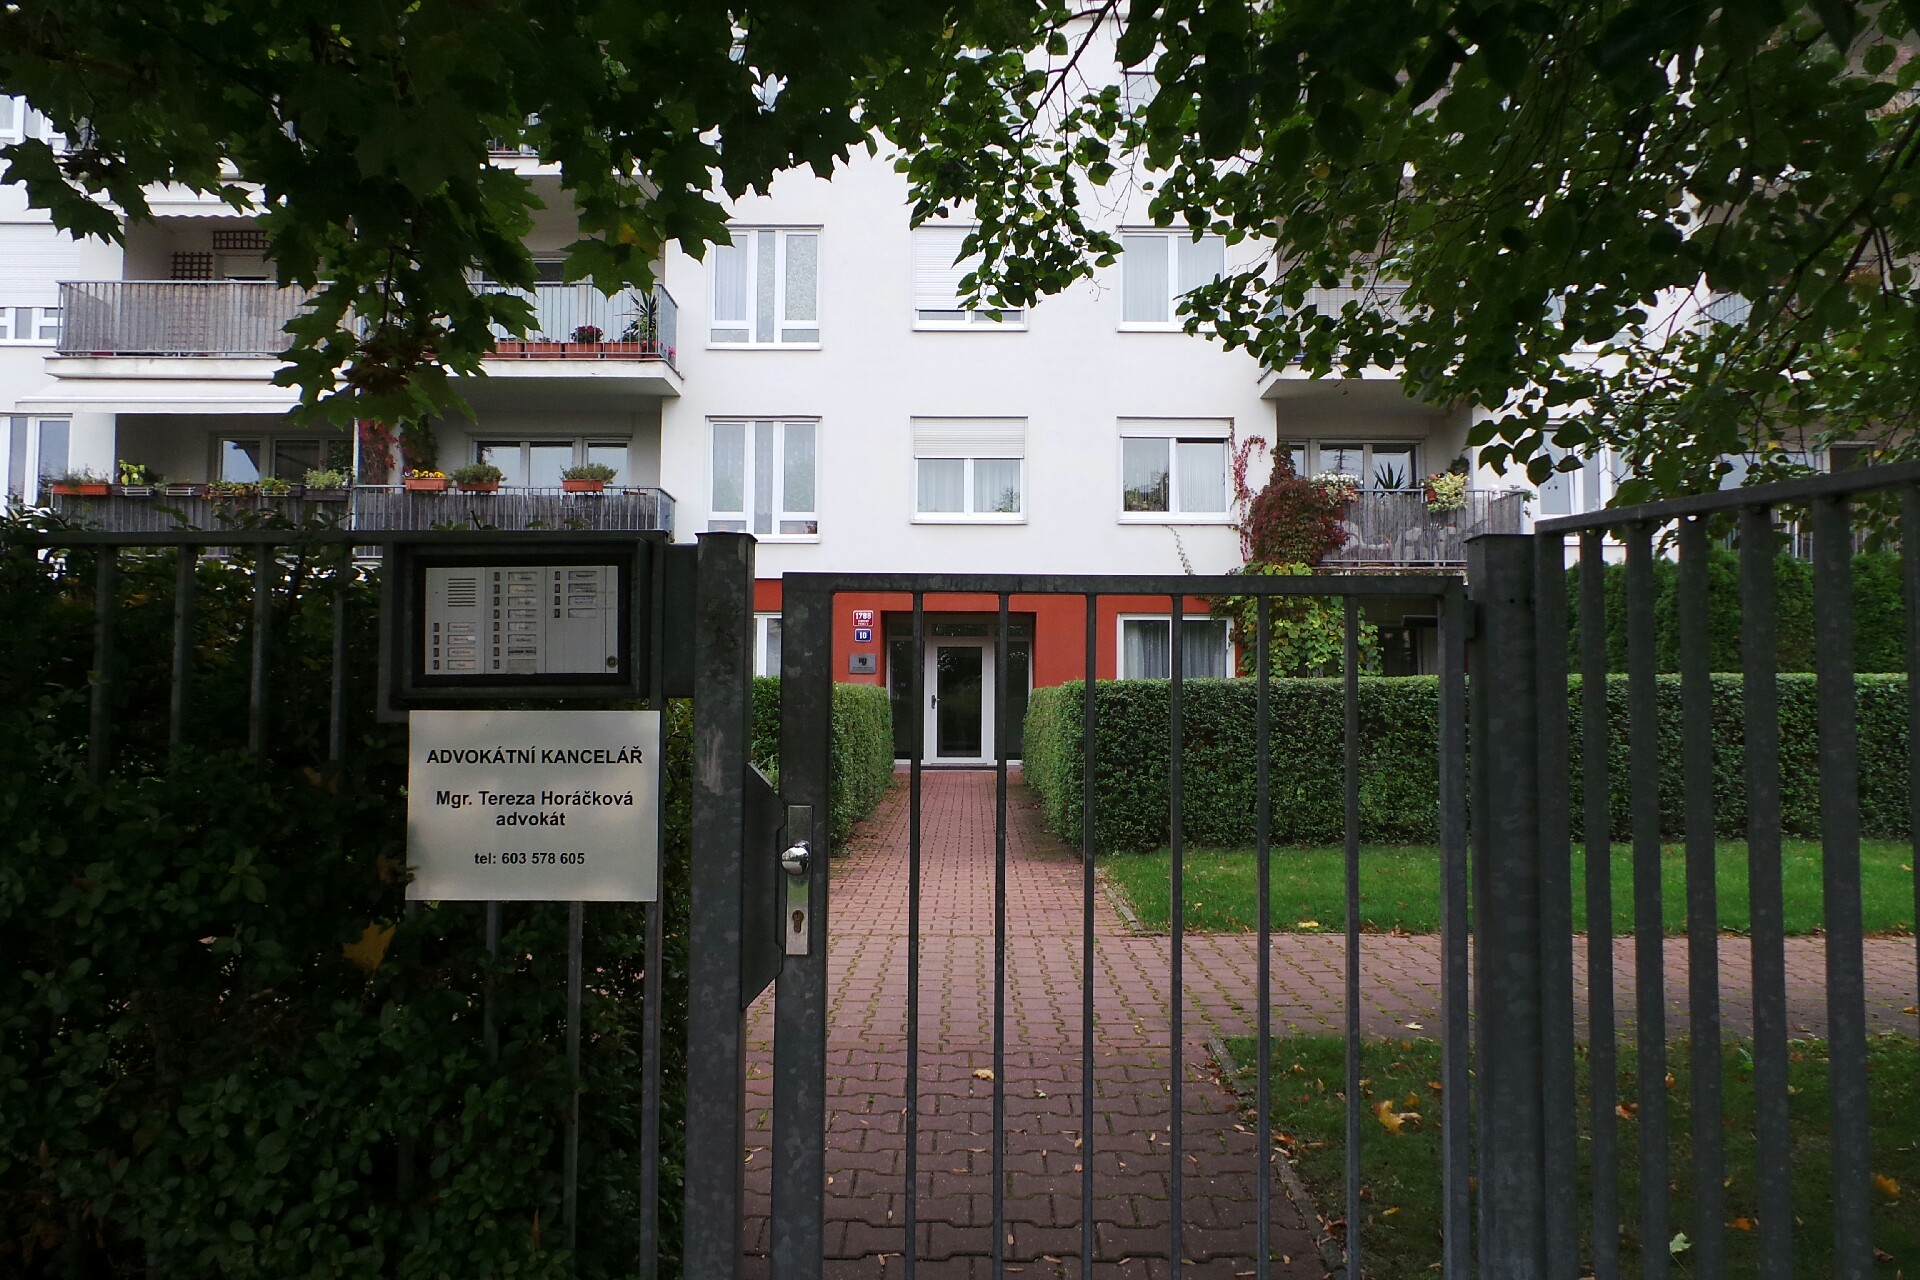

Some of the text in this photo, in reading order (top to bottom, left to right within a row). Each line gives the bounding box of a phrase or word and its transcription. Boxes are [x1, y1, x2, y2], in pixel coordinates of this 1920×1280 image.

[427, 746, 643, 764] ADVOKÁTNÍ KANCELÁŘ
[436, 791, 633, 808] Mgr. Tereza Horáčková
[496, 812, 566, 826] advokát
[474, 852, 585, 864] tel: 603 578 605
